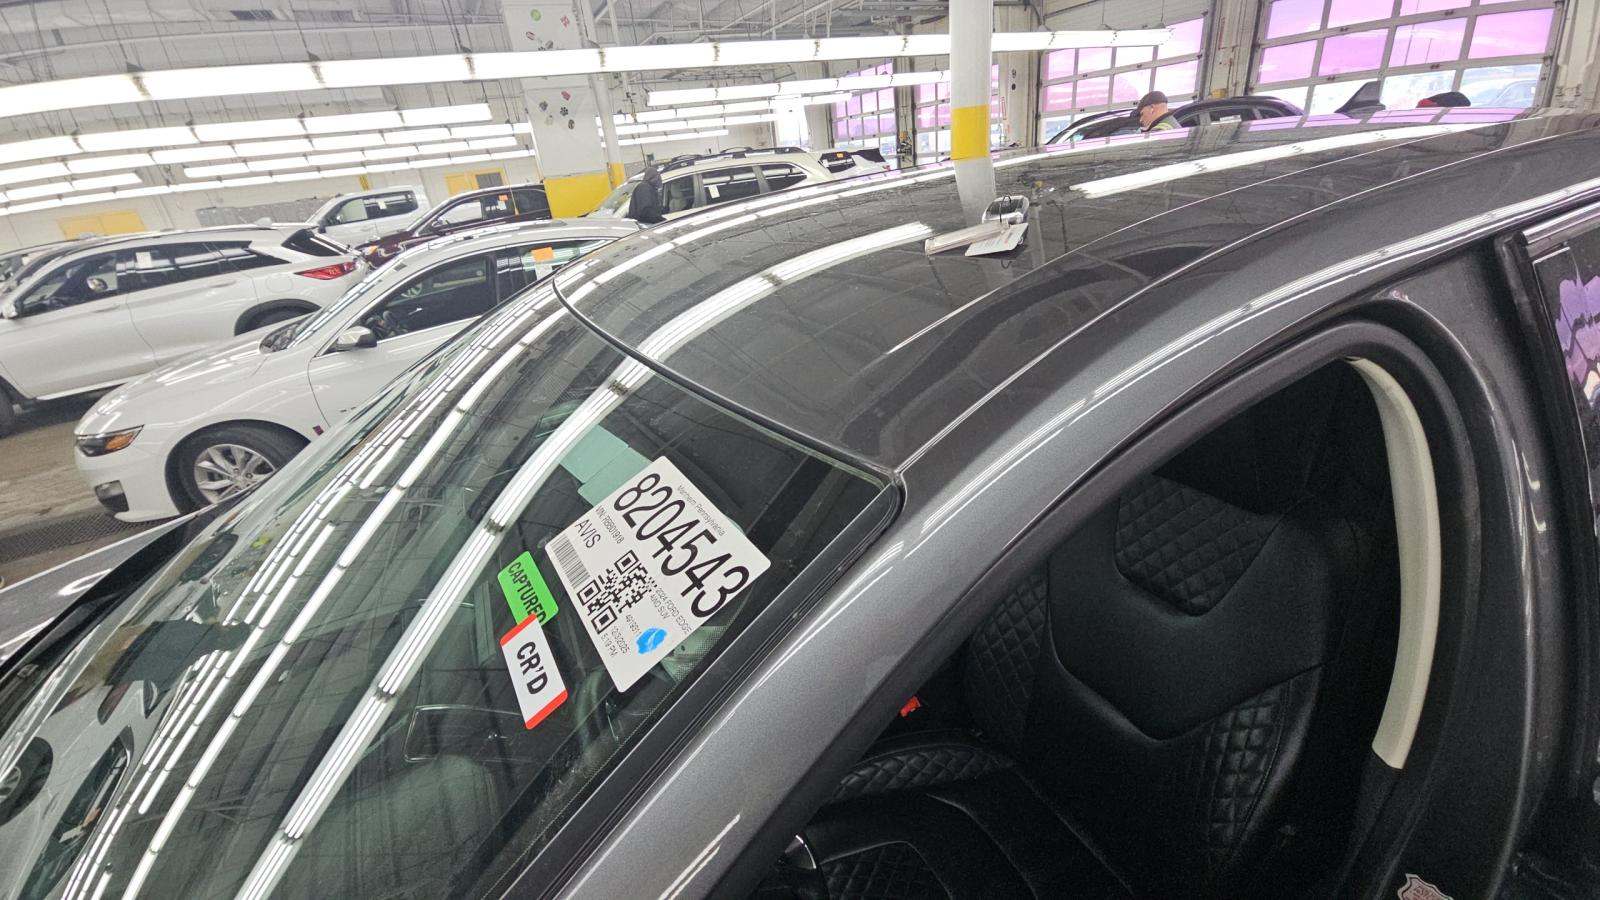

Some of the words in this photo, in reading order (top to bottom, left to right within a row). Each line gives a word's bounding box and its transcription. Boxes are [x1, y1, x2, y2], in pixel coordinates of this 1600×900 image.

[575, 518, 601, 549] AVIS
[696, 503, 726, 537] Pennsylvania
[613, 473, 750, 618] 8204543
[655, 588, 669, 602] 2024
[665, 599, 680, 618] FORD
[676, 616, 693, 635] EDGE
[658, 605, 671, 620] SUV
